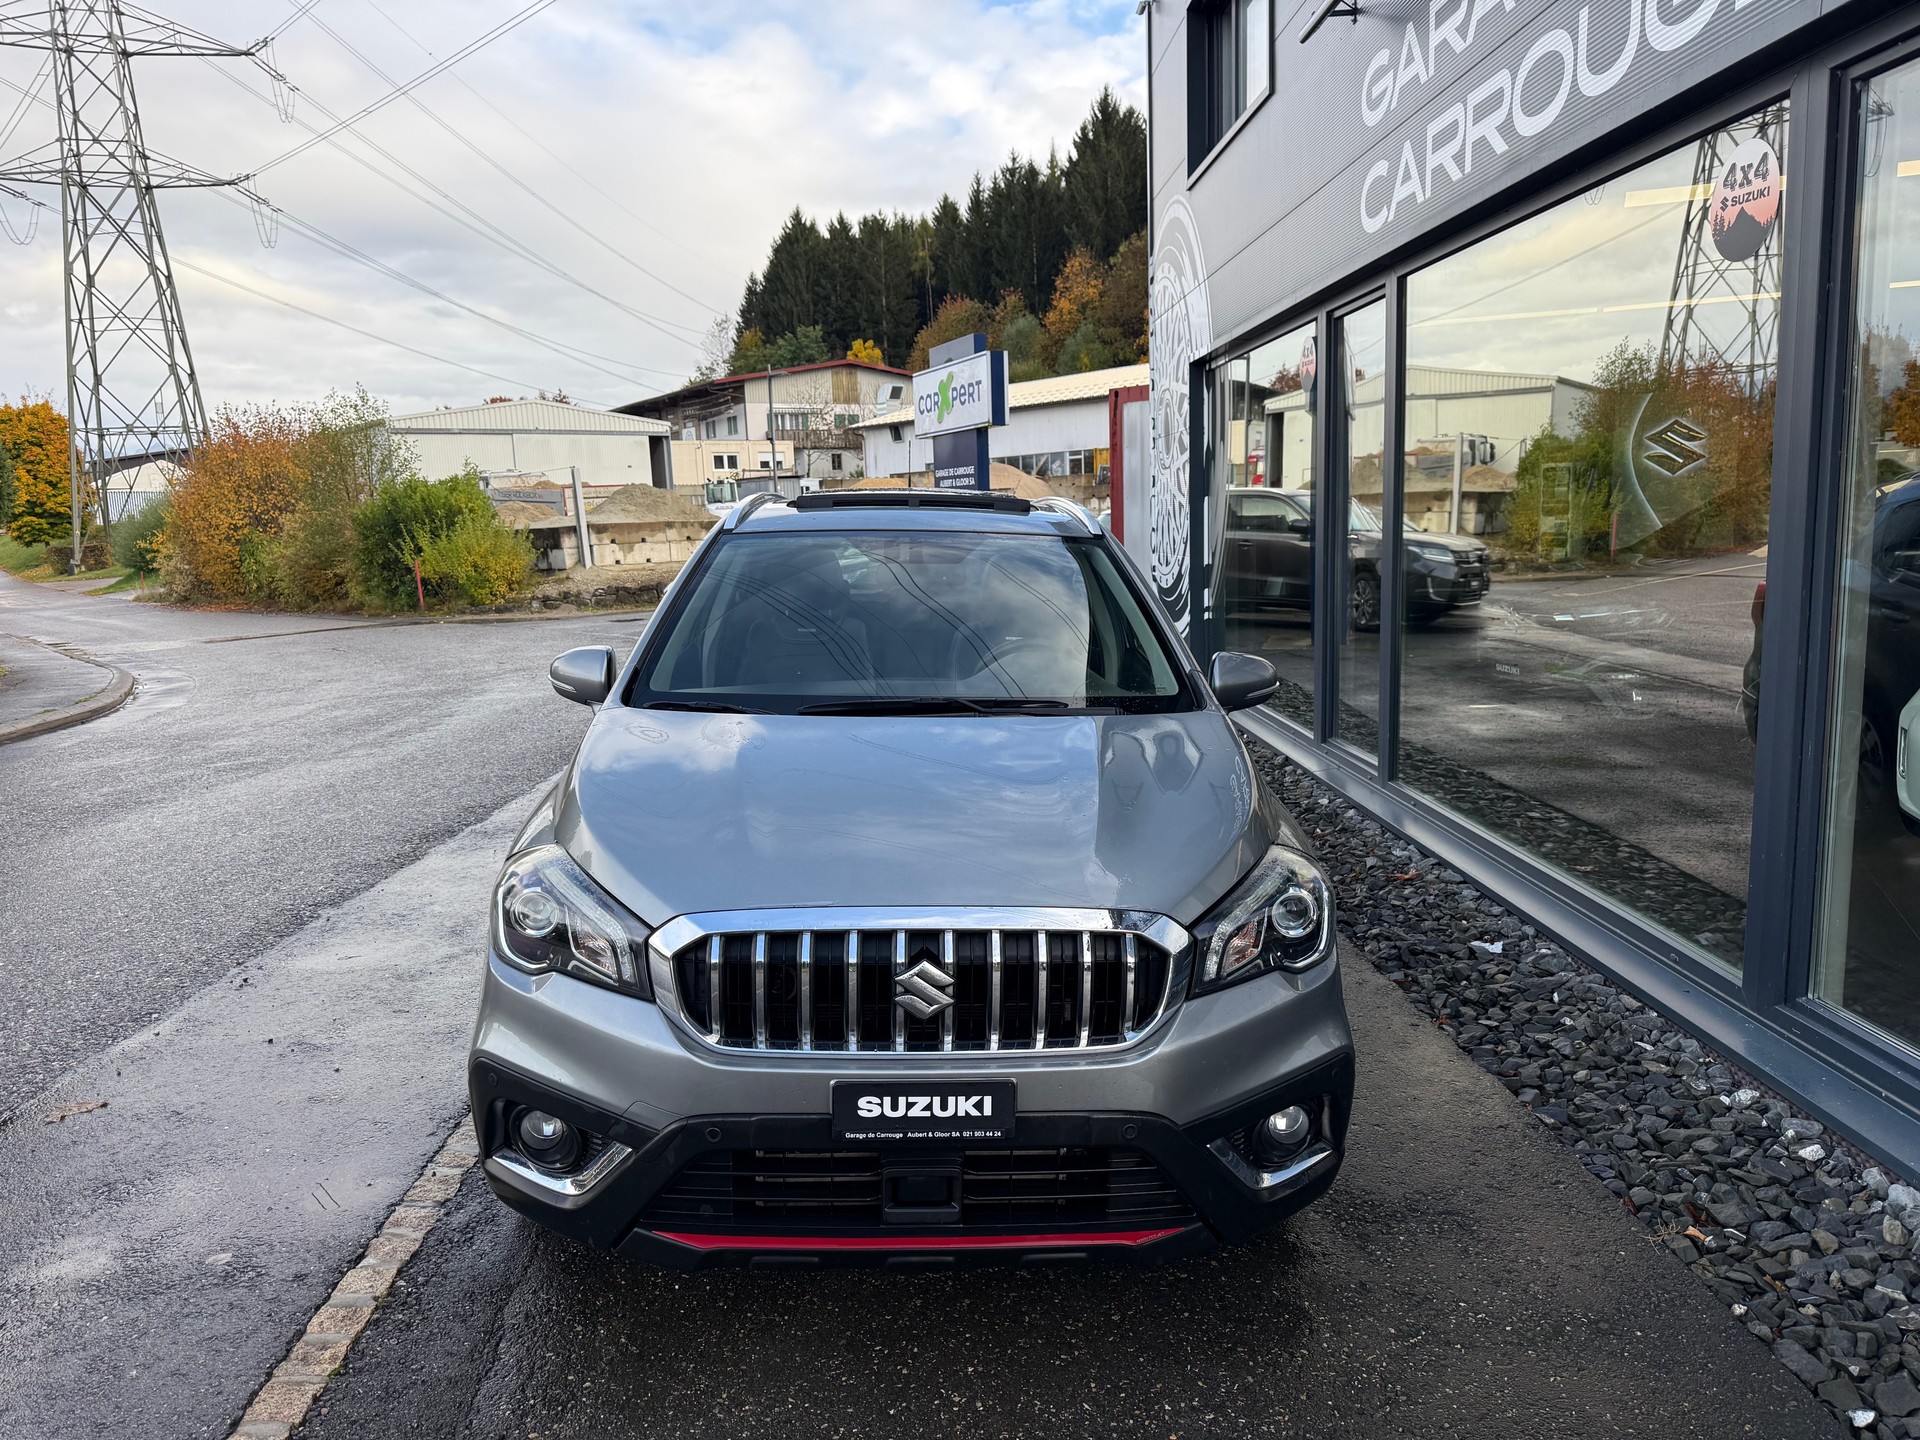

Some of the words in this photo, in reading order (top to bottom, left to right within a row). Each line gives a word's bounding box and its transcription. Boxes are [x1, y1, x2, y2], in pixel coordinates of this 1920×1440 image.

[1722, 151, 1770, 192] 4x4
[1731, 186, 1771, 207] SUZUKI
[1495, 663, 1520, 675] SUZUKI
[857, 1095, 992, 1118] SUZUKI
